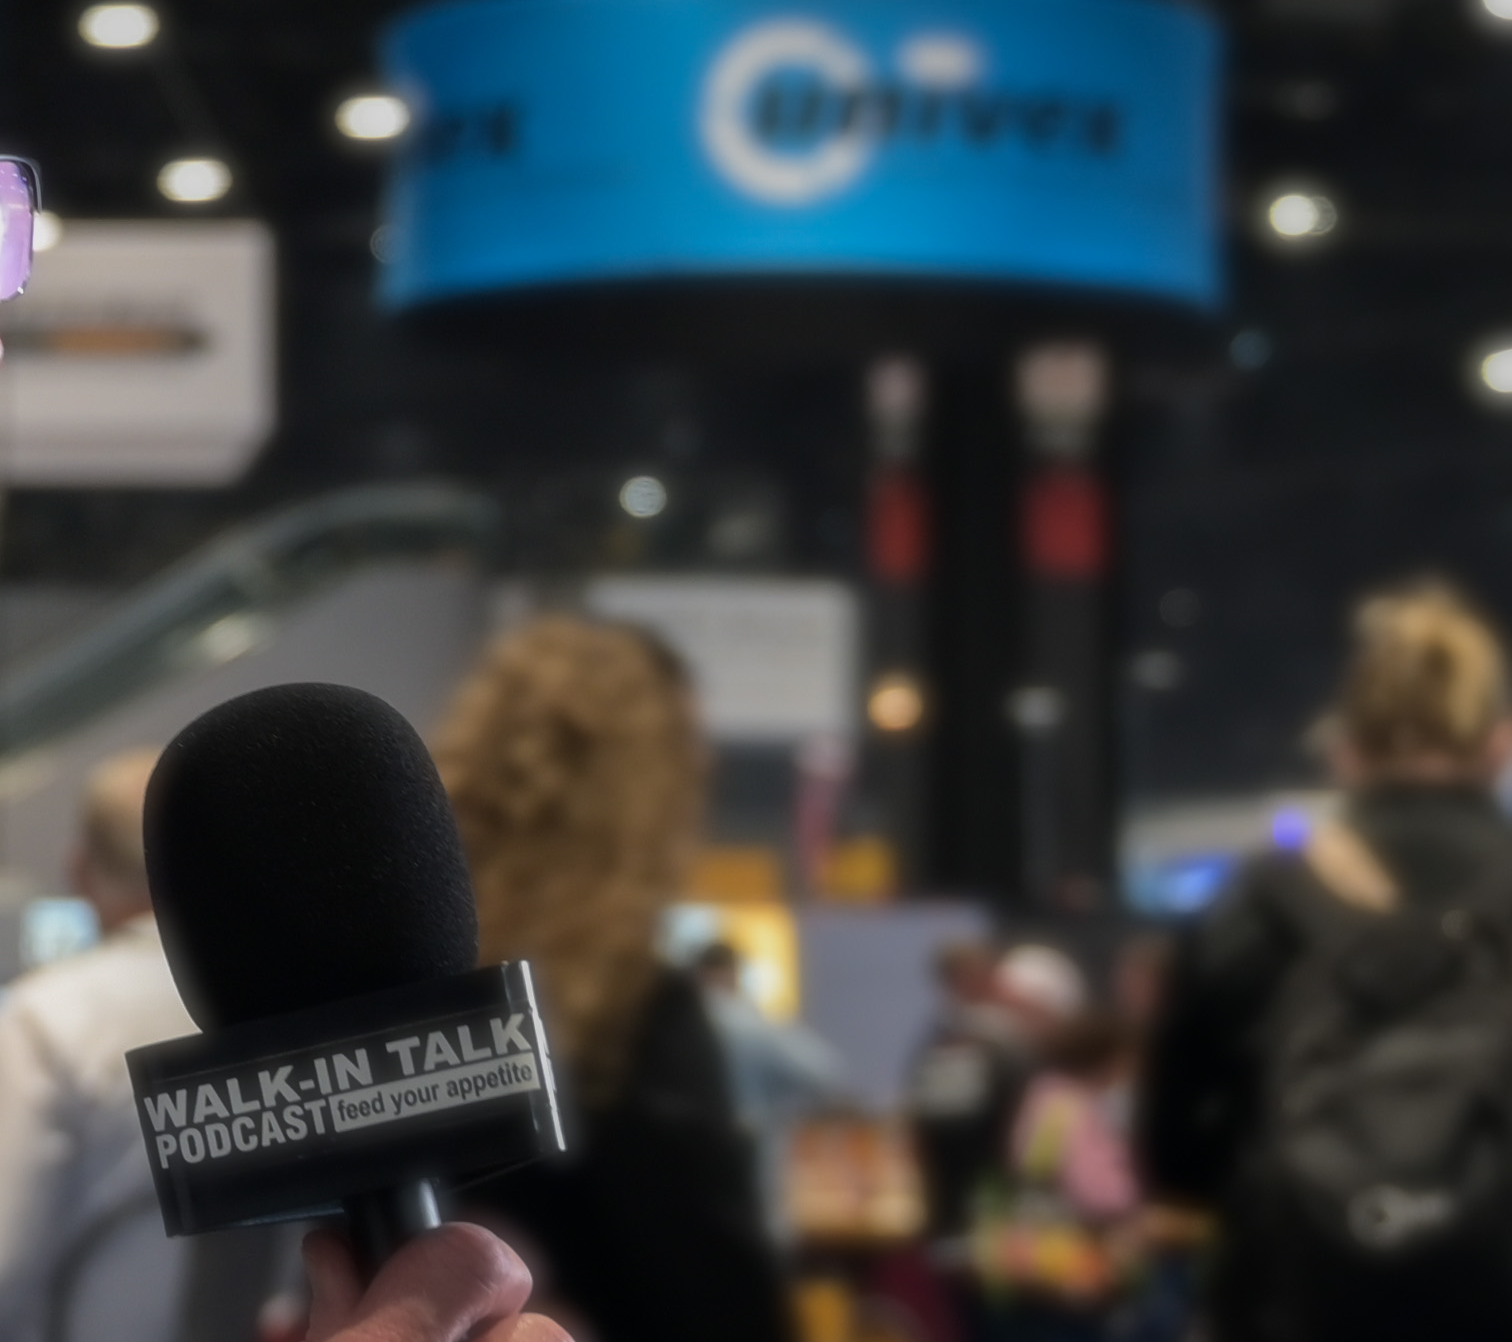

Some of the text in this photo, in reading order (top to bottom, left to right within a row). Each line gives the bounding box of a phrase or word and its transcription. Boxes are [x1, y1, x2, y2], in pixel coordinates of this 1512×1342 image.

[143, 1012, 533, 1133] WALK-IN TALK
[337, 1061, 534, 1122] feed your appetite
[155, 1098, 328, 1169] PODCAST
